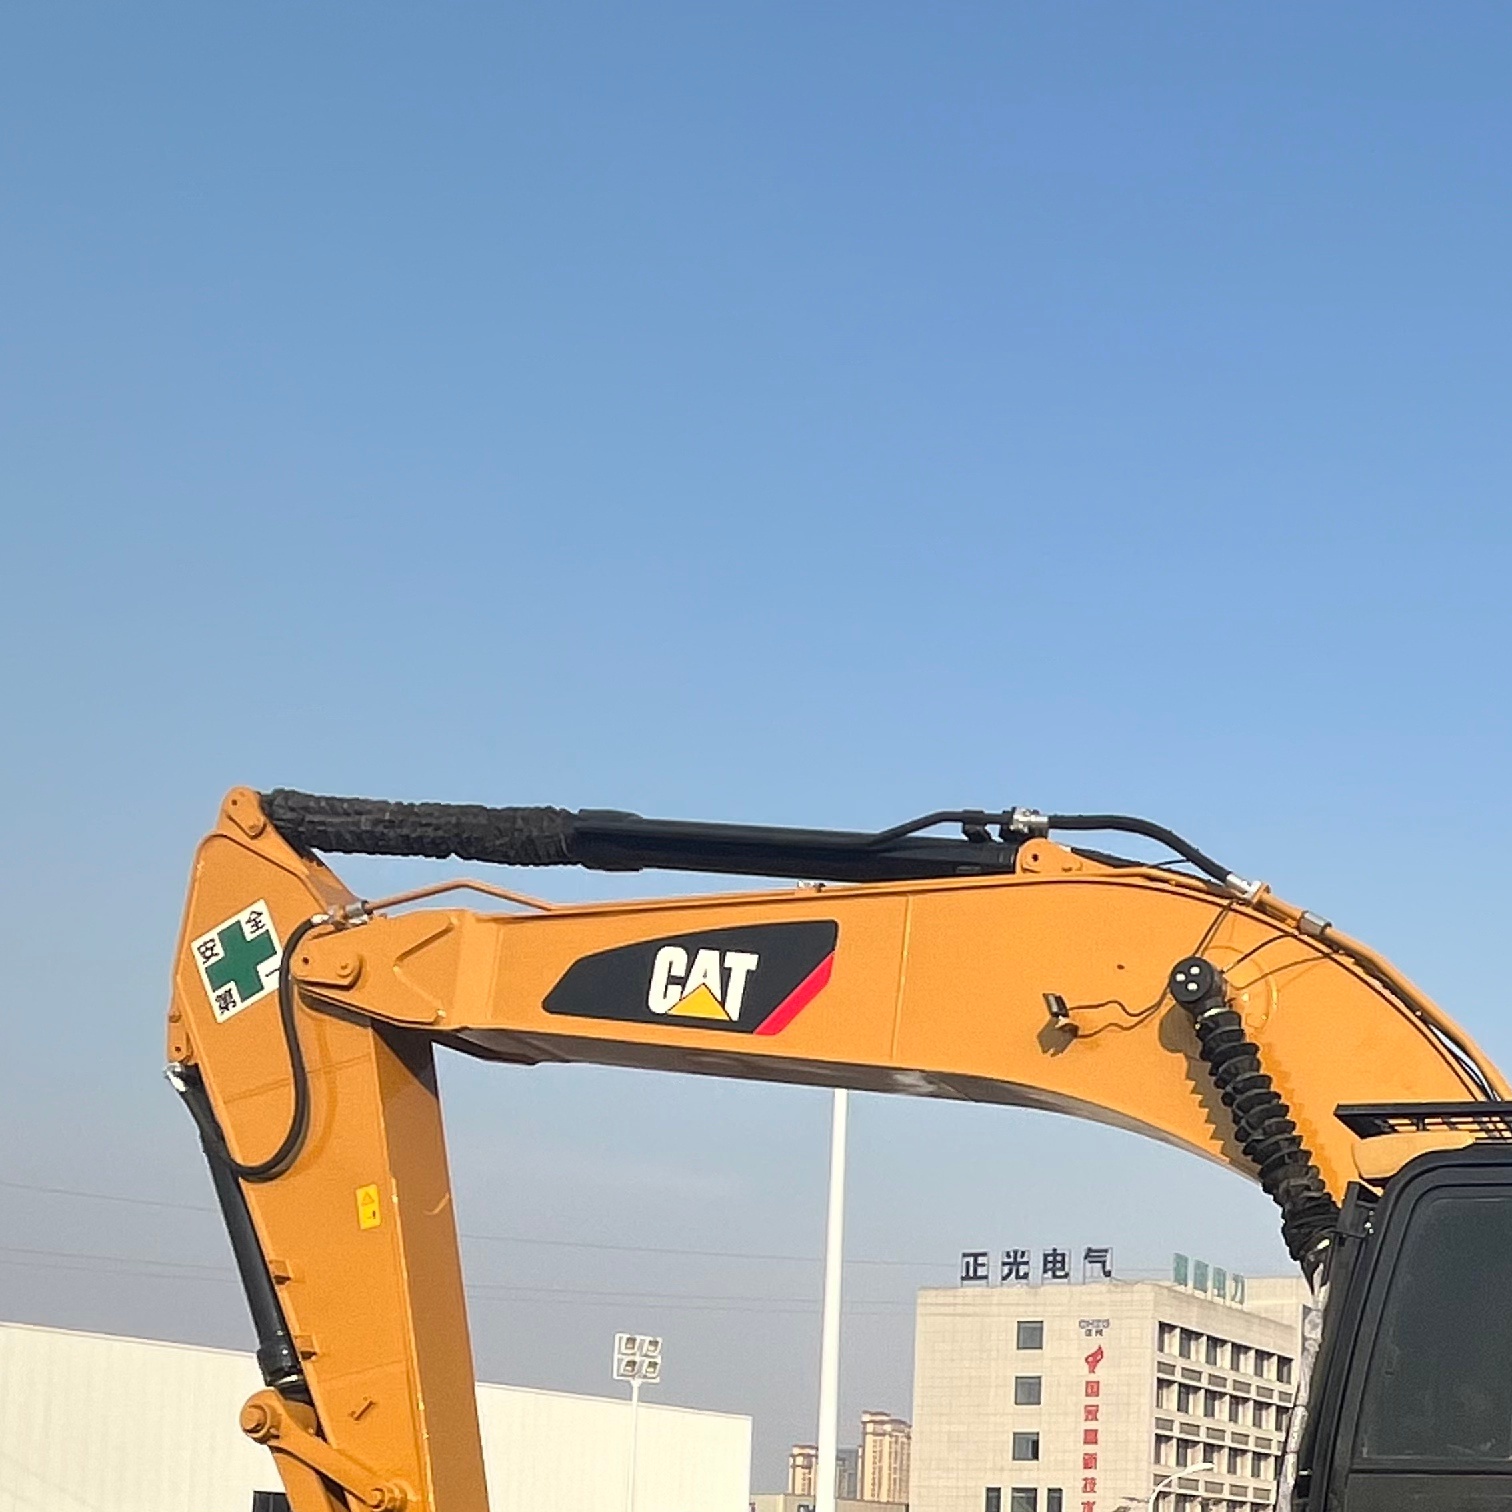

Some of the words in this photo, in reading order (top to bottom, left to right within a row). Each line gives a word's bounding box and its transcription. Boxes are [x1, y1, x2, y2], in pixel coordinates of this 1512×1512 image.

[647, 945, 759, 1021] CAT
[961, 1247, 1112, 1282] 正光电气
